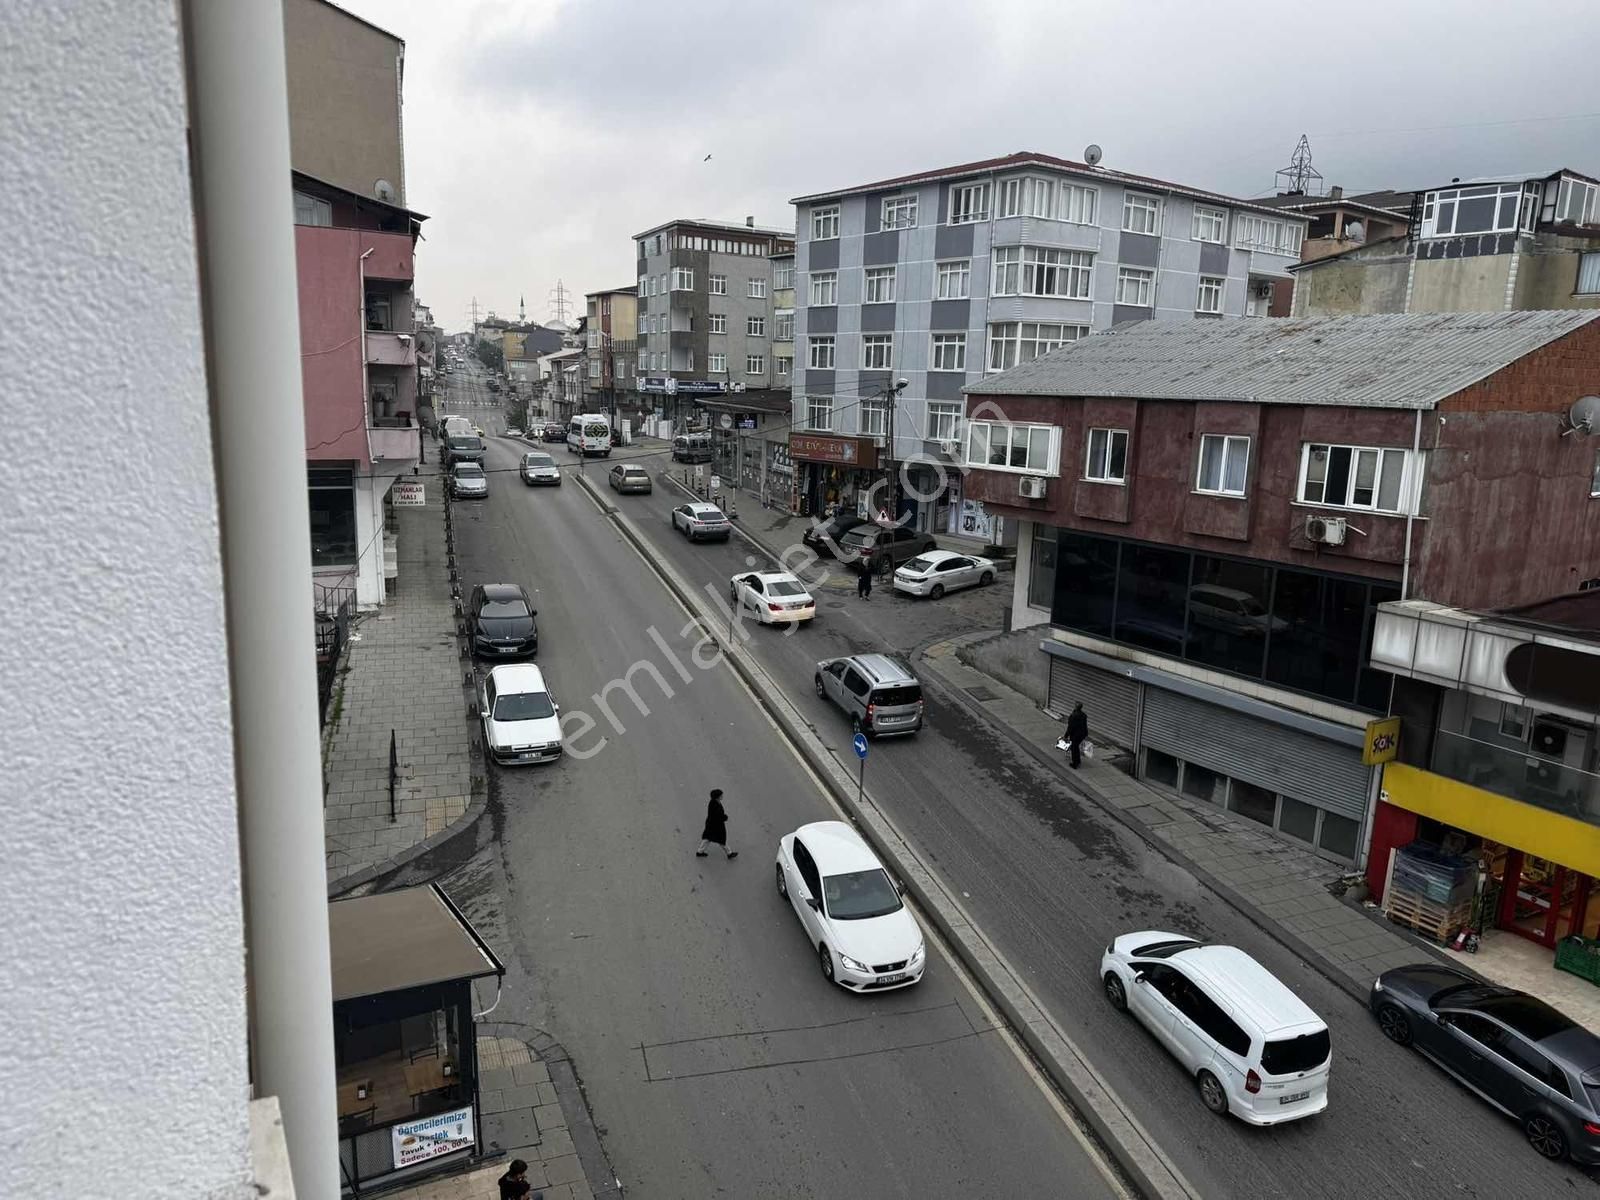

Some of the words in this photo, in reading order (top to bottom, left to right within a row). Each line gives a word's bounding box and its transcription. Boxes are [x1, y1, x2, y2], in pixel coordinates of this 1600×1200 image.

[418, 1130, 449, 1142] Destek
[400, 1145, 425, 1156] Tavuk
[400, 1151, 431, 1164] Sadece
